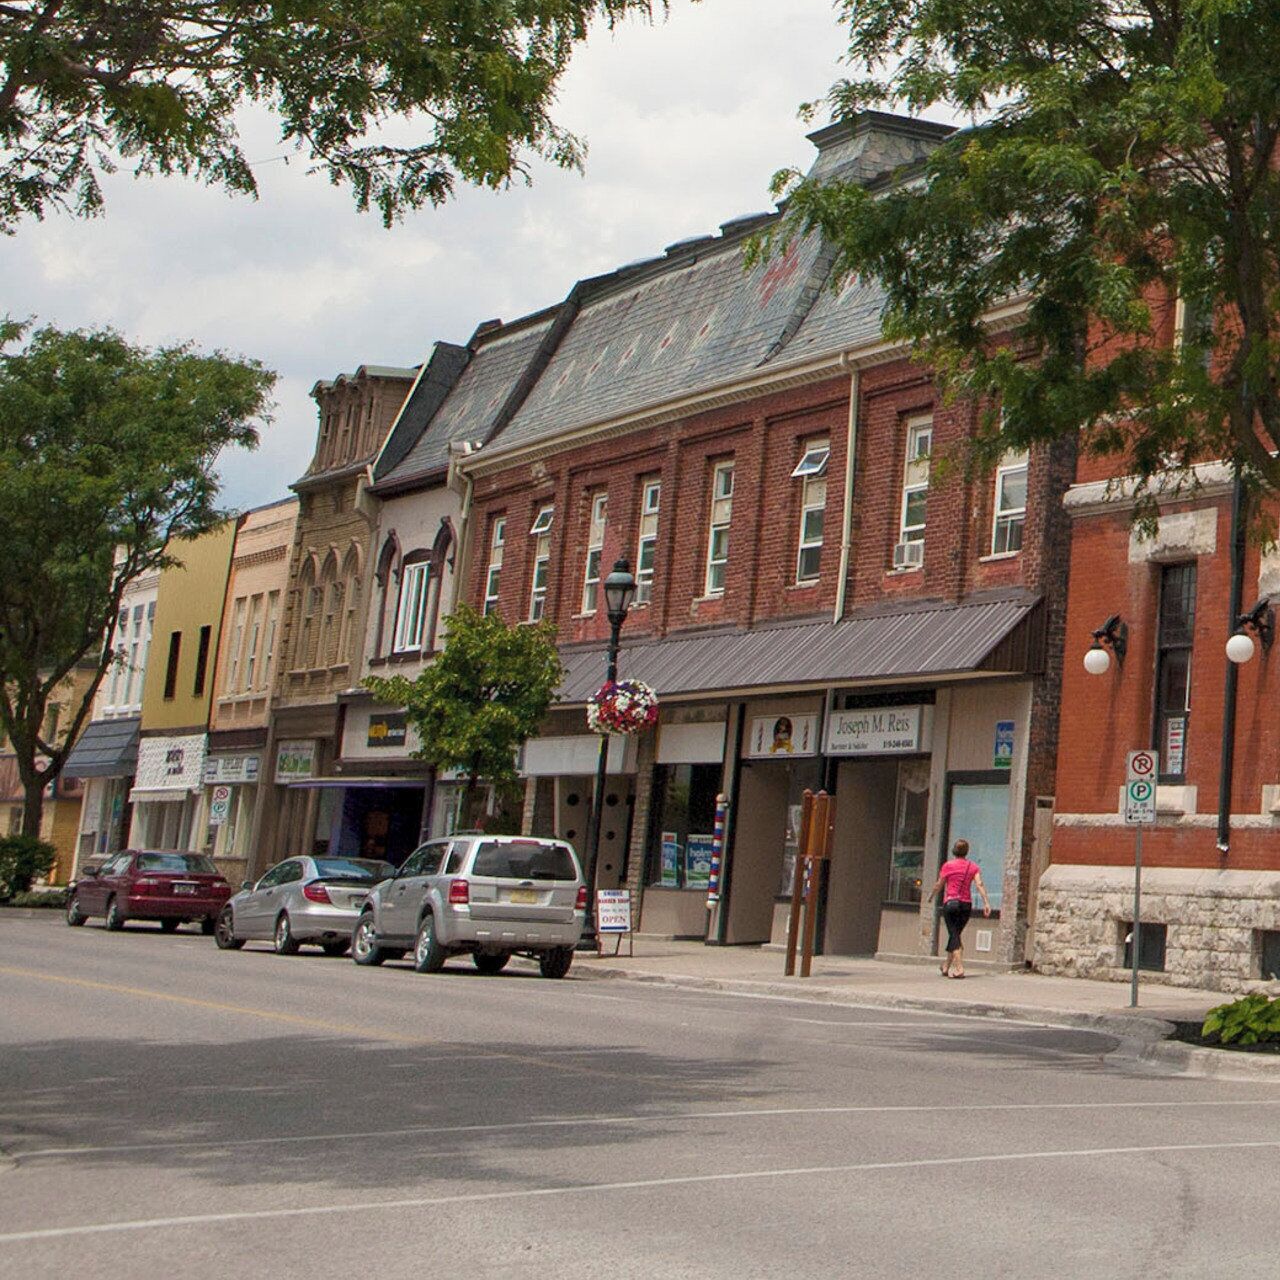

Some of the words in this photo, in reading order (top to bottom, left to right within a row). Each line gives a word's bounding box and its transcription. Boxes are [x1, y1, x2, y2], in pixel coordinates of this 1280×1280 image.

[836, 715, 870, 738] Joseph
[872, 714, 885, 733] M.
[888, 712, 911, 732] Reis
